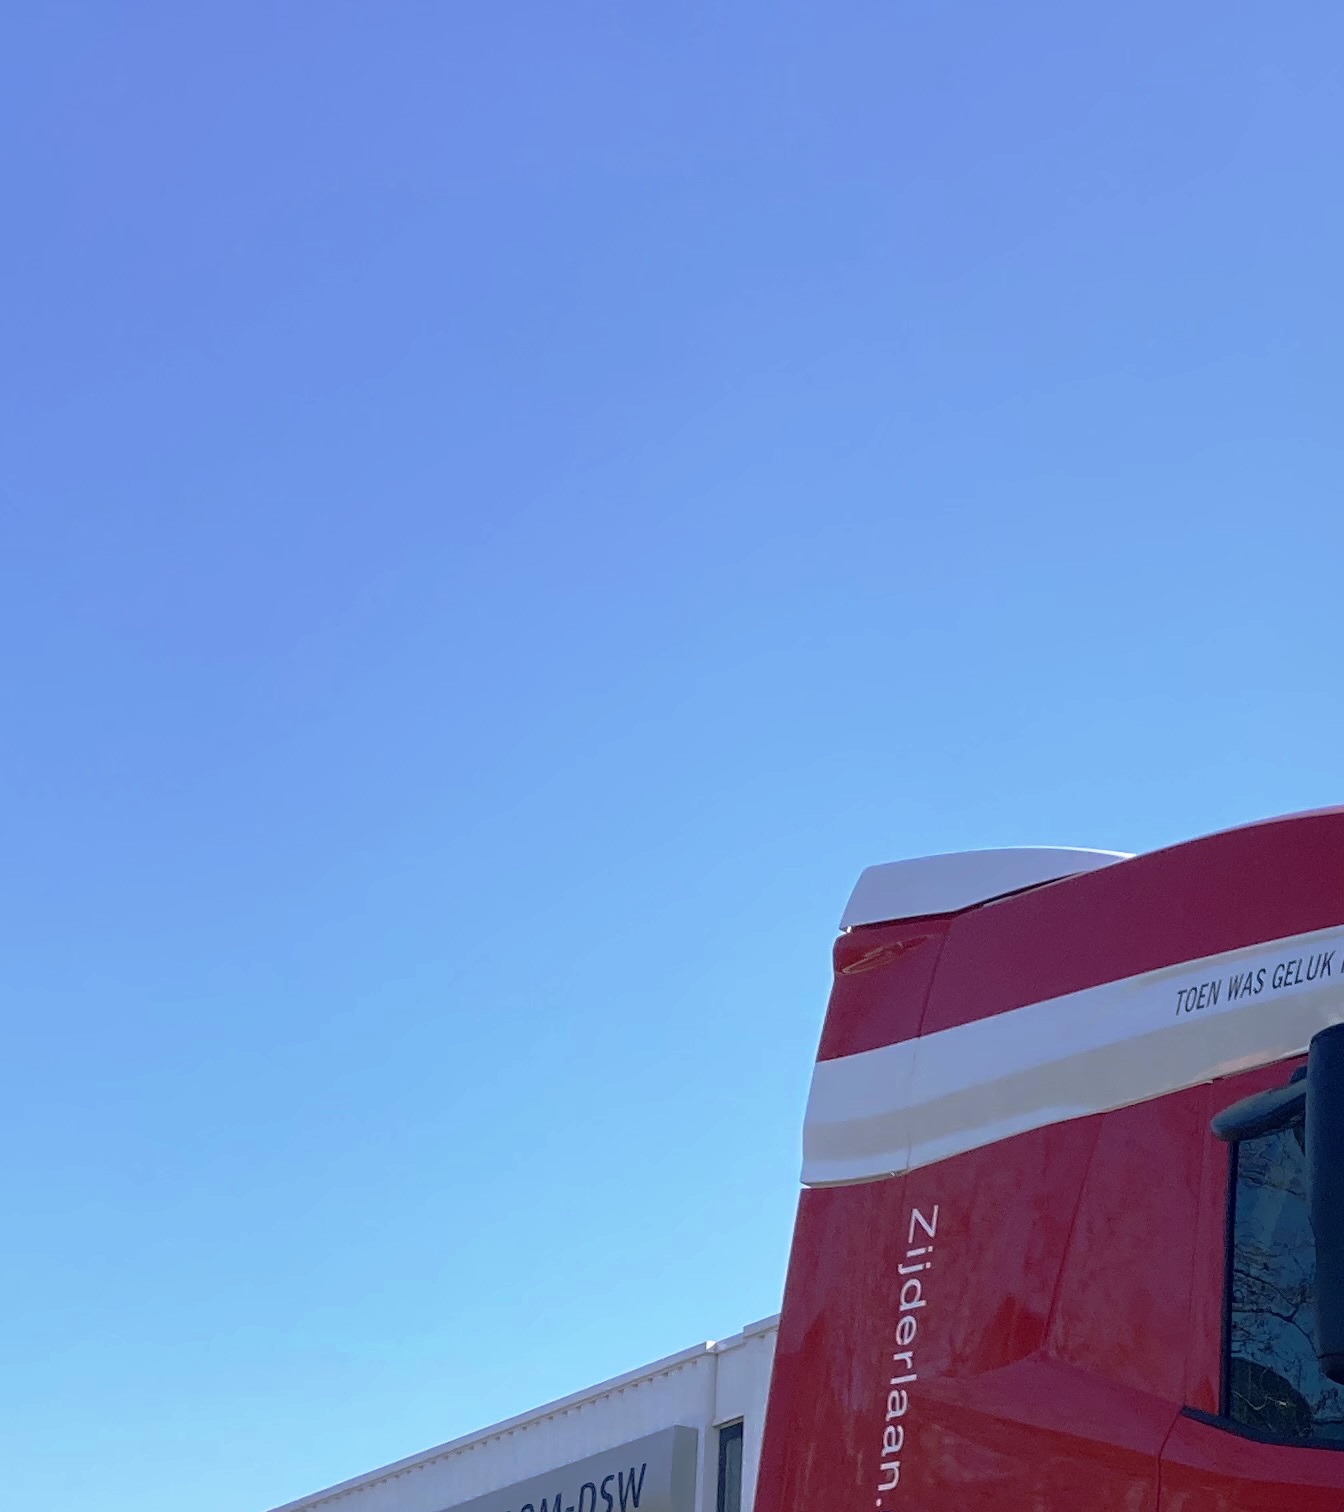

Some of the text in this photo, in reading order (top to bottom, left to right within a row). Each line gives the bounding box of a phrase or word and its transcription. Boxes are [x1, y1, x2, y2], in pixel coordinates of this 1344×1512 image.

[1175, 978, 1222, 1016] TOEN
[1226, 967, 1268, 1002] WAS
[1271, 950, 1337, 990] GELUK
